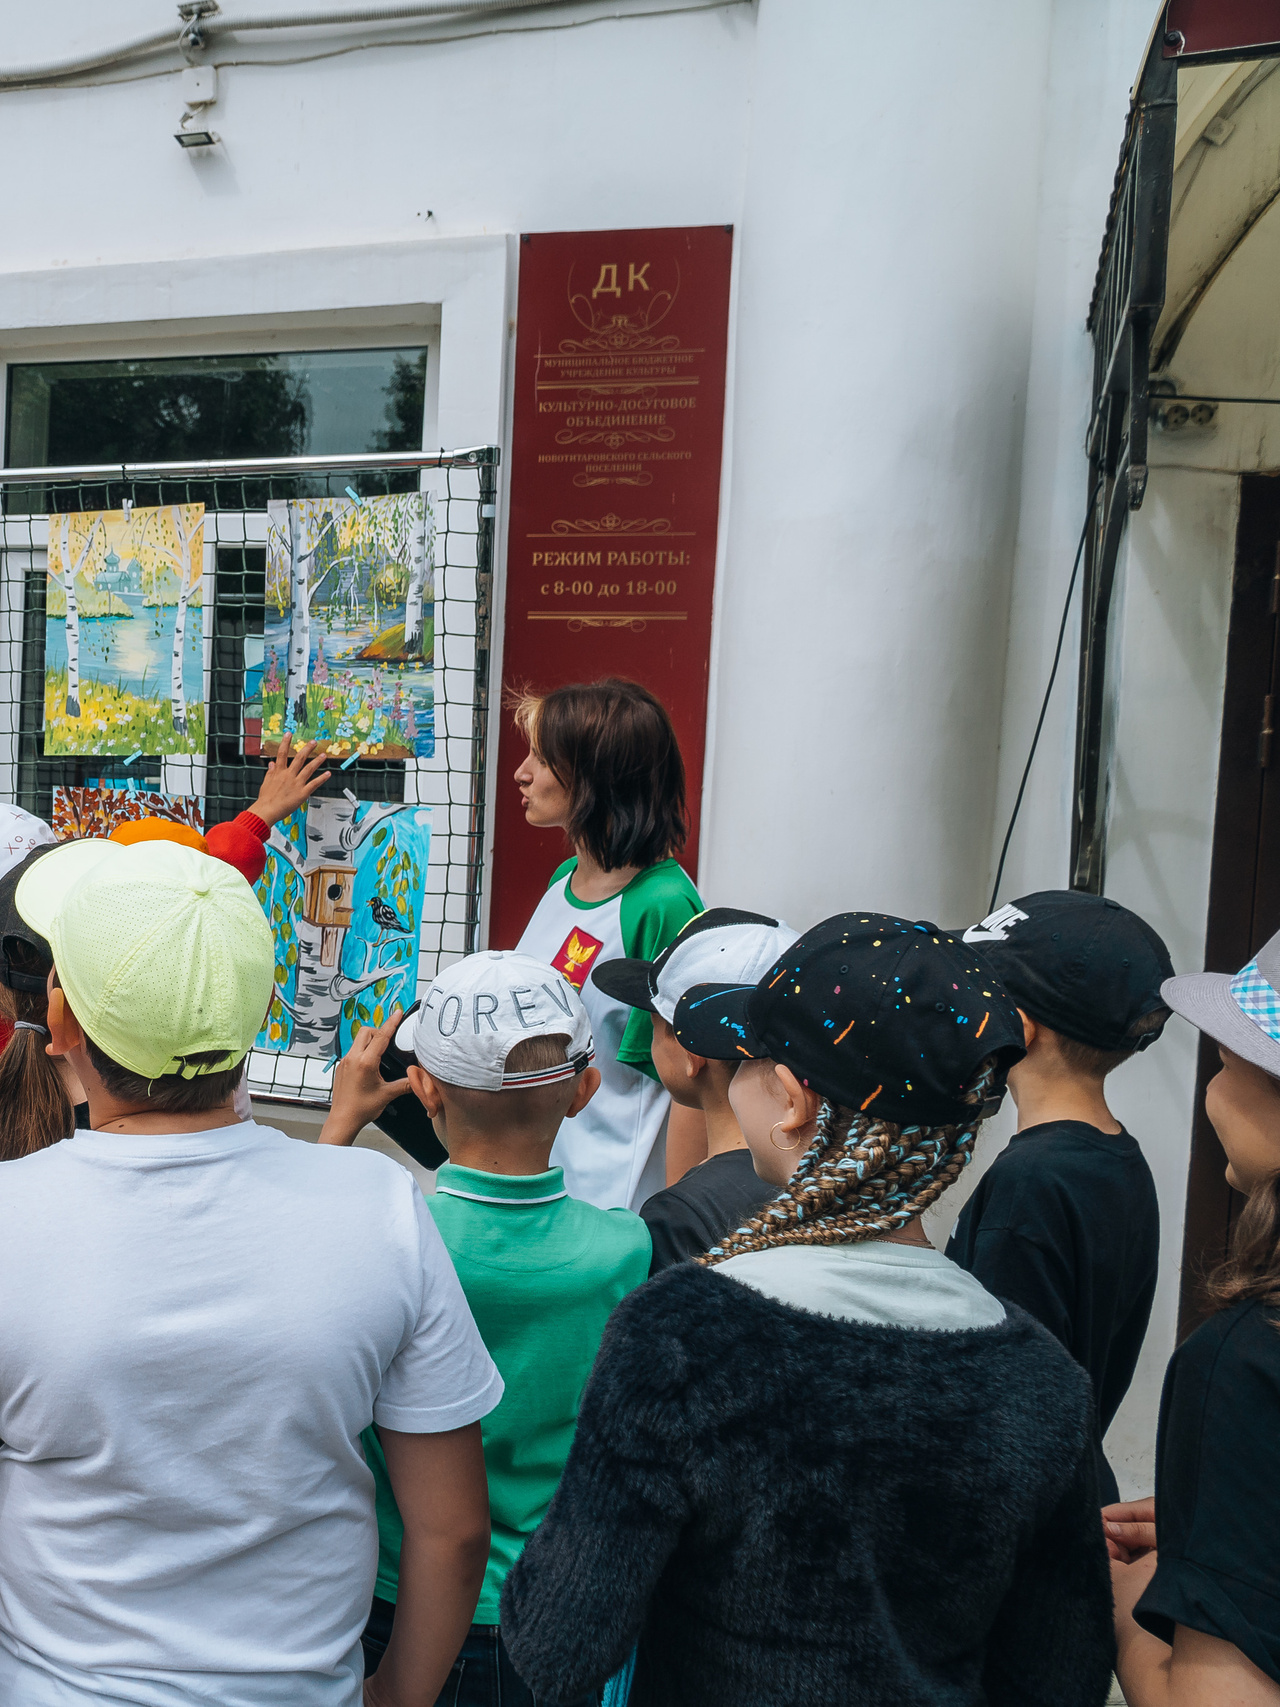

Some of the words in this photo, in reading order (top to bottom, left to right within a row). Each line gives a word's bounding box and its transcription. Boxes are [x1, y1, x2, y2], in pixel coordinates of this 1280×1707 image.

[592, 262, 651, 299] ДК
[544, 357, 630, 368] МУНИЦИПАЛЬНОЕ
[631, 354, 694, 366] БЮДЖЕТНОЕ
[560, 368, 623, 378] УЧРЕЖДЕНИЕ
[625, 366, 677, 377] КУЛЬТУРЫ
[538, 397, 697, 413] КУЛЬТУРНО-ДОСУГОВОЕ
[566, 414, 666, 428] ОБЪЕДИНЕНИЕ
[538, 452, 636, 464] НОВОТИТАРОВСКОГО
[637, 451, 692, 462] СЕЛЬСКОГО
[585, 463, 642, 473] ПОСЕЛЕНИЯ
[532, 551, 601, 566] РЕЖИМ
[607, 551, 691, 566] РАБОТЫ:
[540, 583, 550, 595] с
[554, 580, 593, 596] 8-00
[597, 582, 620, 598] до
[626, 580, 677, 596] 18-00
